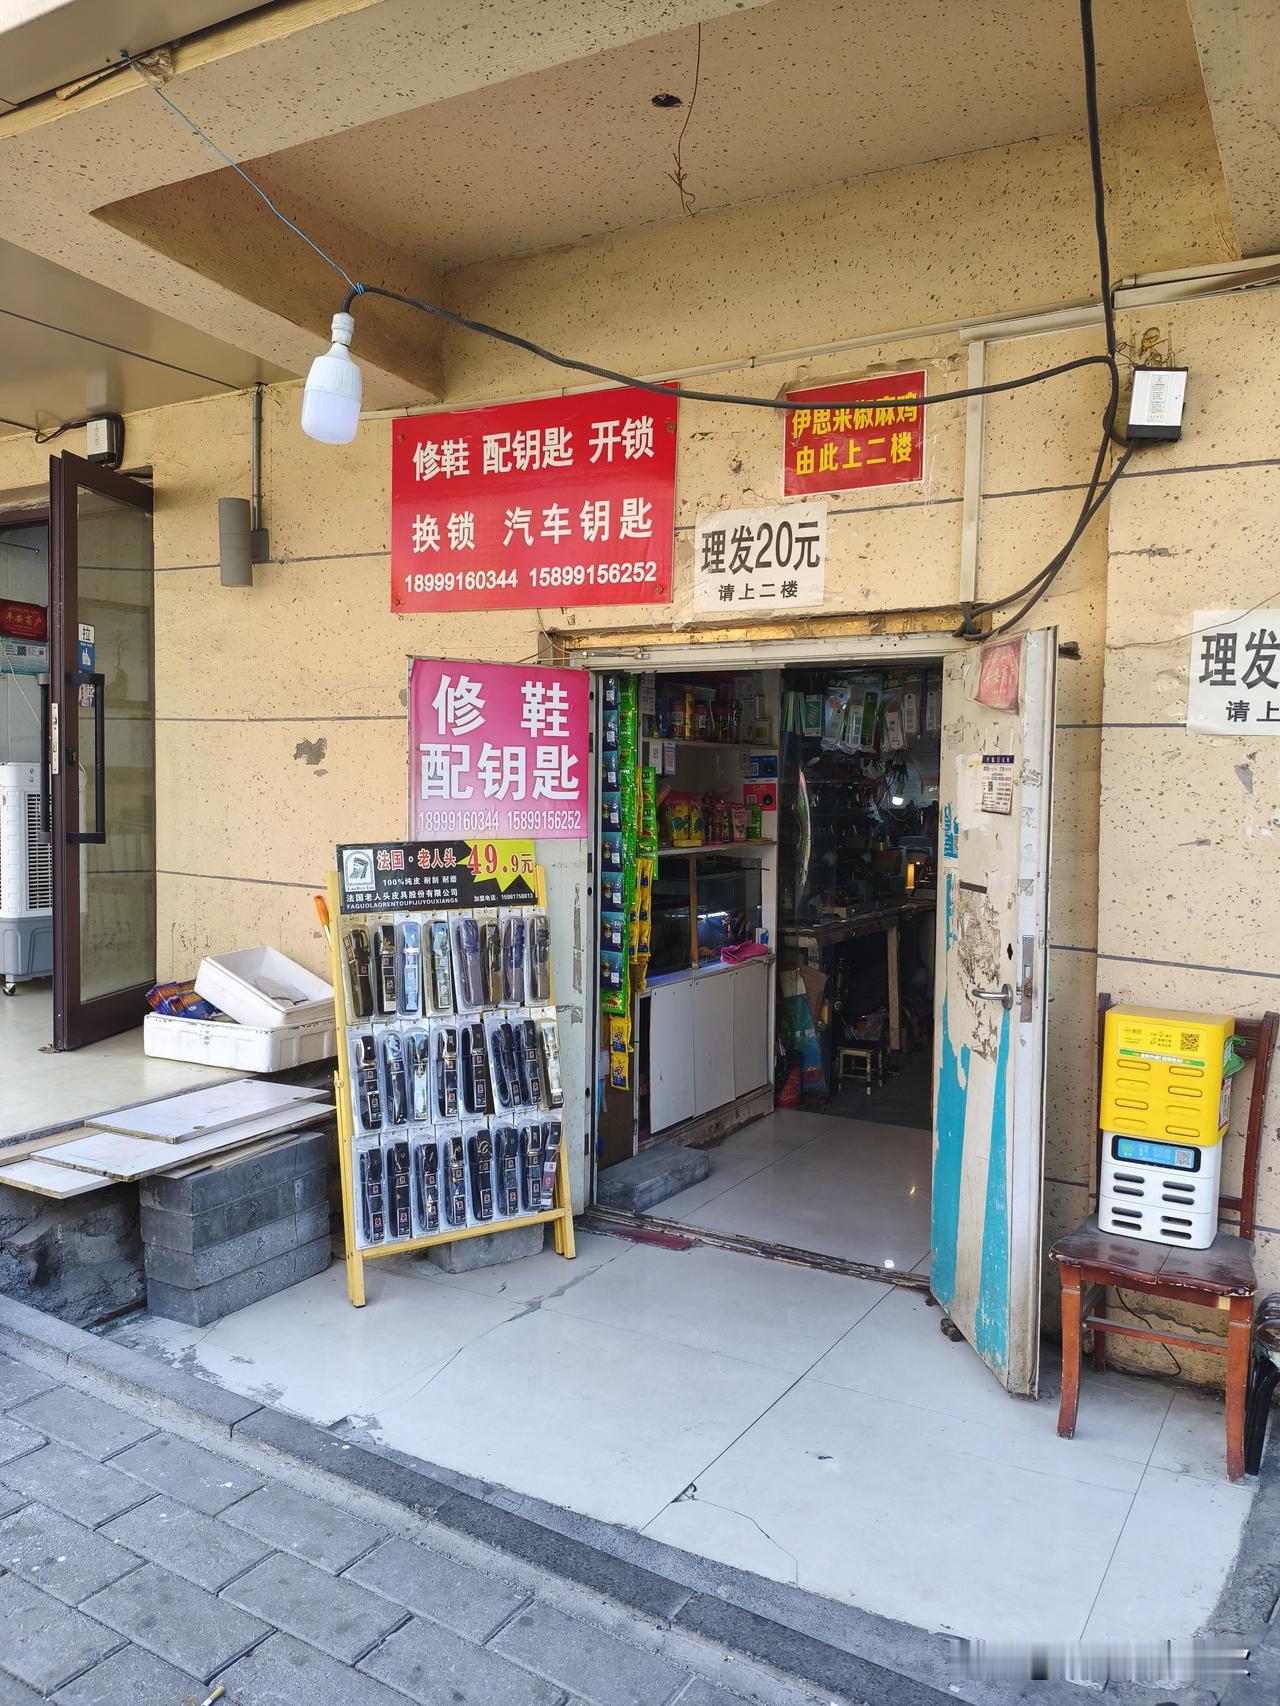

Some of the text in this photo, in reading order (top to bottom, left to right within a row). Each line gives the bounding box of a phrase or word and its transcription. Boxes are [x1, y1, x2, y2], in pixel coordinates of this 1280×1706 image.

[412, 415, 655, 481] 修鞋 配钥匙 开锁
[795, 431, 912, 476] 由此上二楼
[411, 496, 654, 554] 换锁 汽车钥匙
[702, 521, 821, 575] 理发20元
[404, 561, 657, 594] 18999160344 15899156252
[718, 580, 799, 602] 请上二楼
[1199, 628, 1280, 690] 理发
[1226, 700, 1280, 723] 请上
[419, 742, 579, 801] 配钥匙
[418, 810, 581, 832] 18999160344 15899156252
[467, 843, 534, 876] 49.9元
[346, 888, 458, 903] 法国老人头皮具股份有限公司
